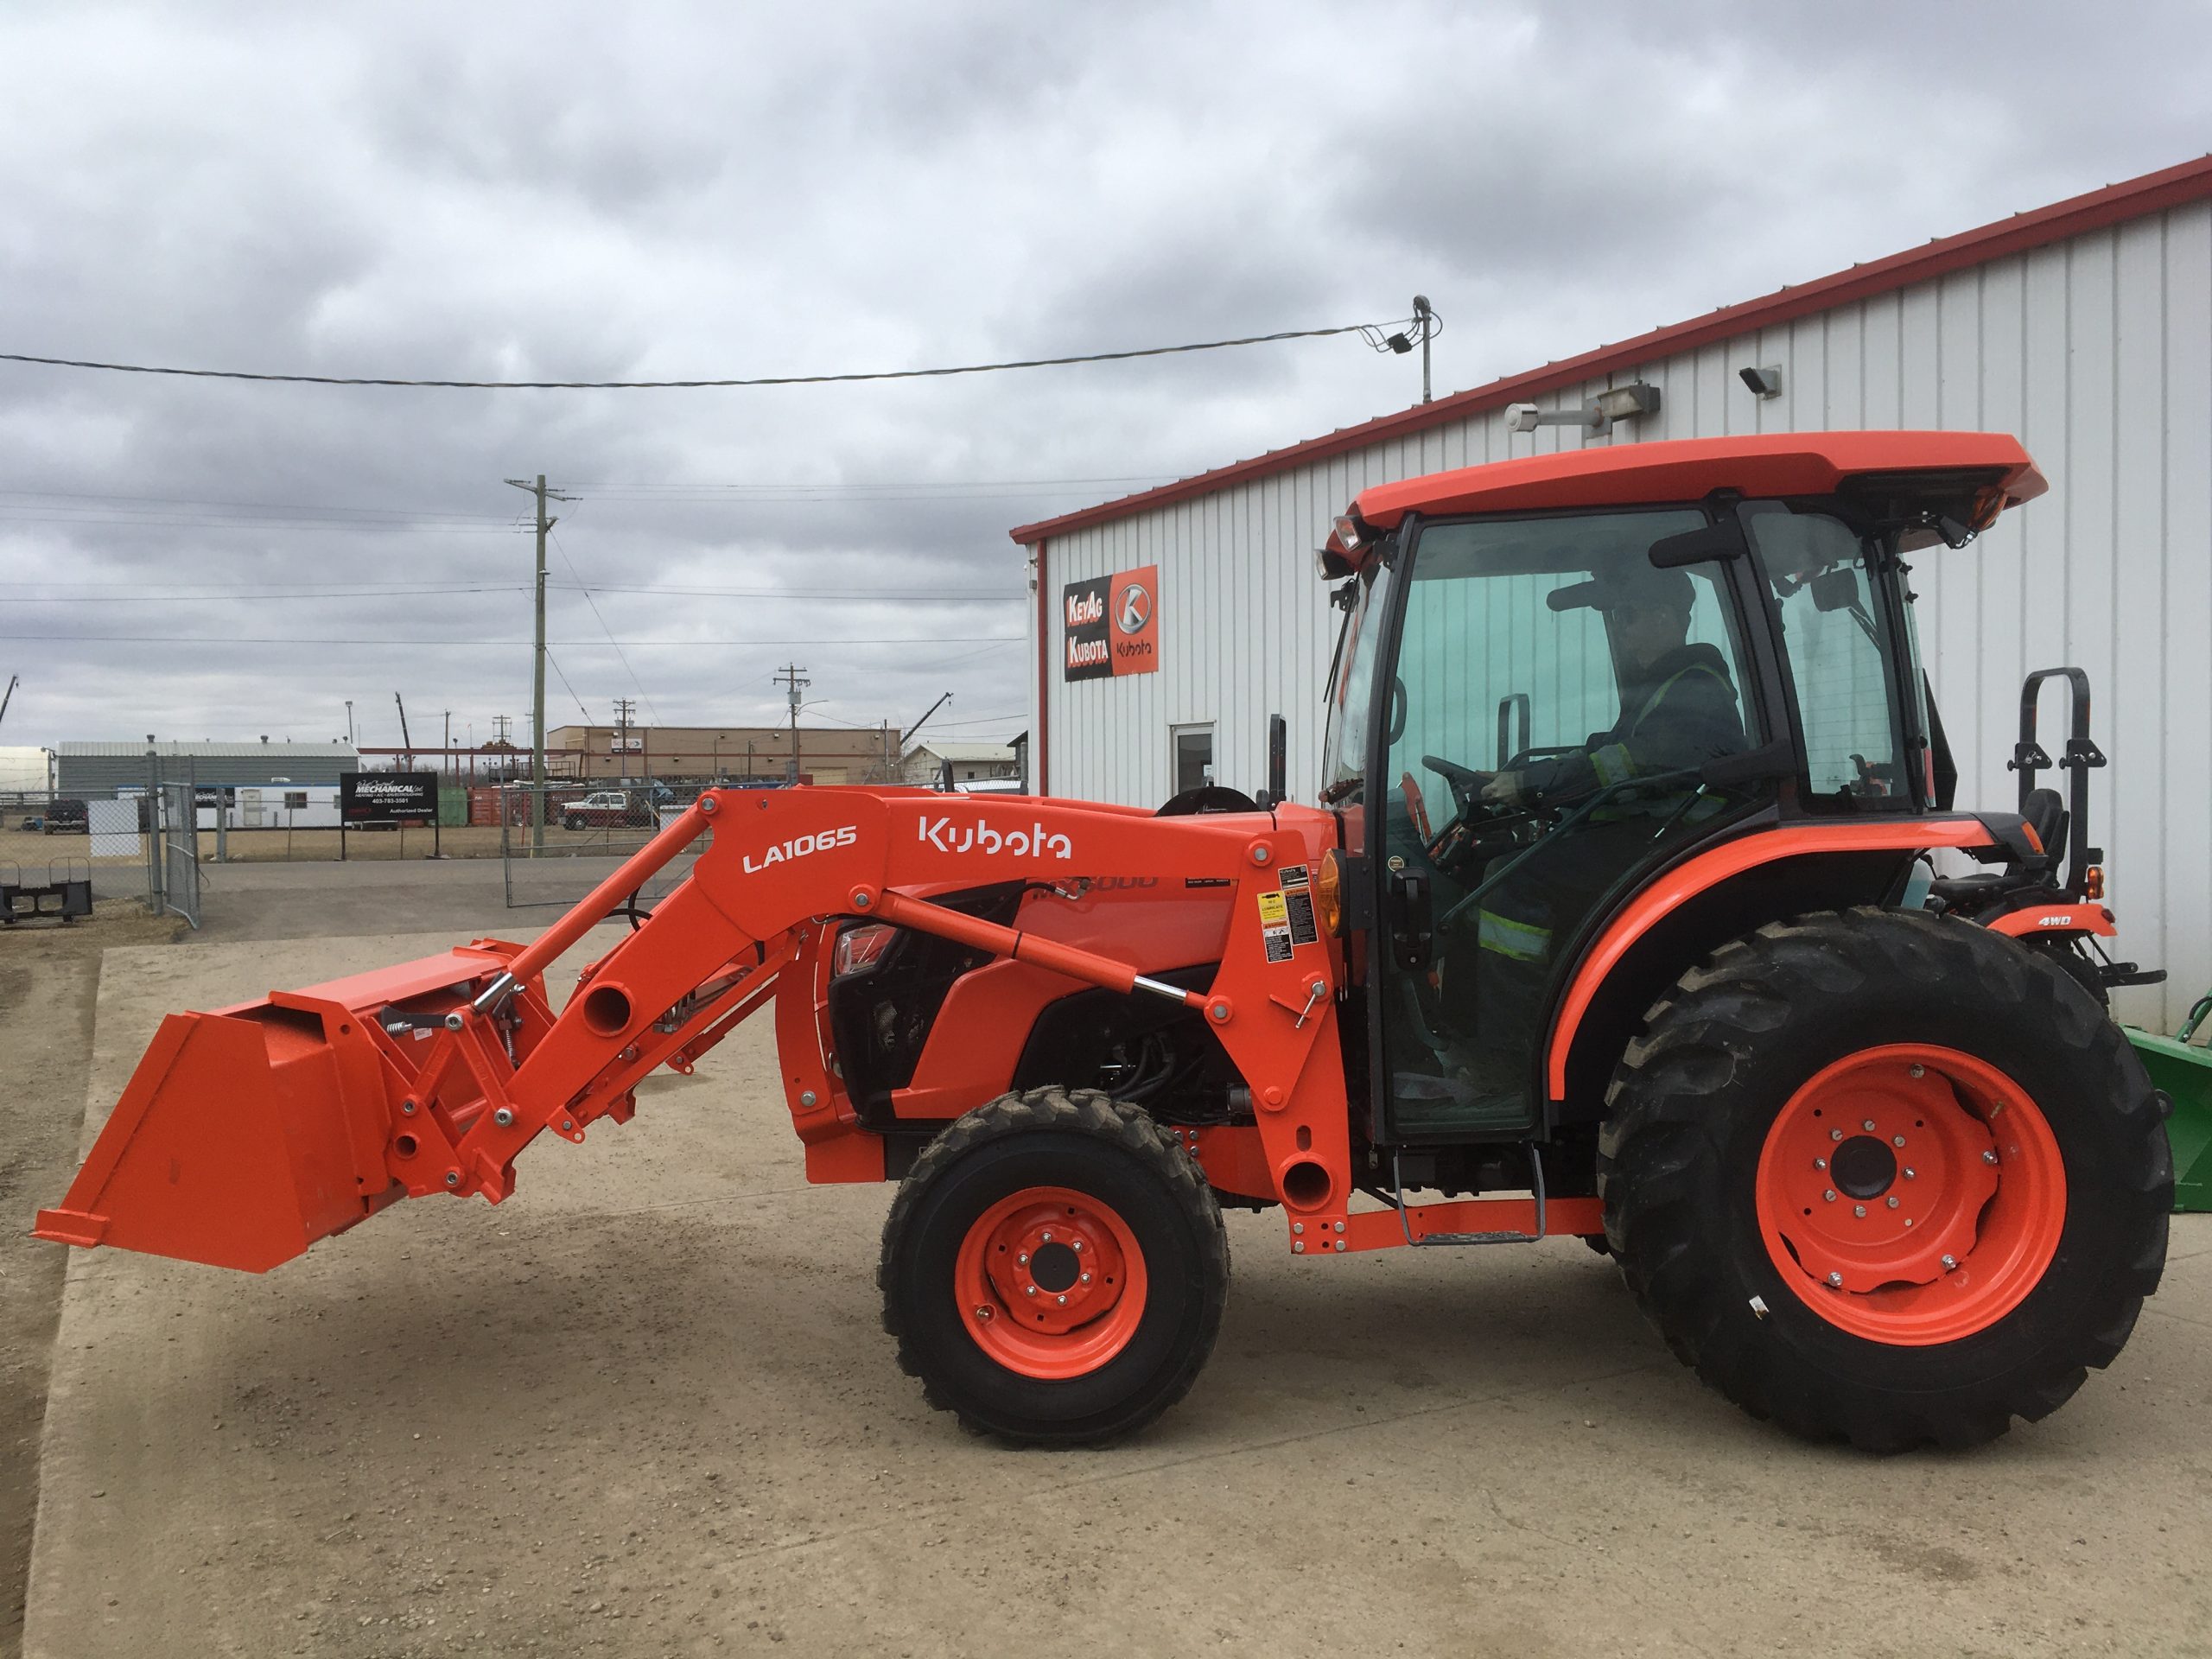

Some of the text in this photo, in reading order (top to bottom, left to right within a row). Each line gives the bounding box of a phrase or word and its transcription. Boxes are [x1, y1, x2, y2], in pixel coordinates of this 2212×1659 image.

[1116, 639, 1152, 657] Kubota
[743, 825, 856, 874] LA1065
[918, 816, 1071, 859] Kubota
[2038, 916, 2071, 926] 4WD
